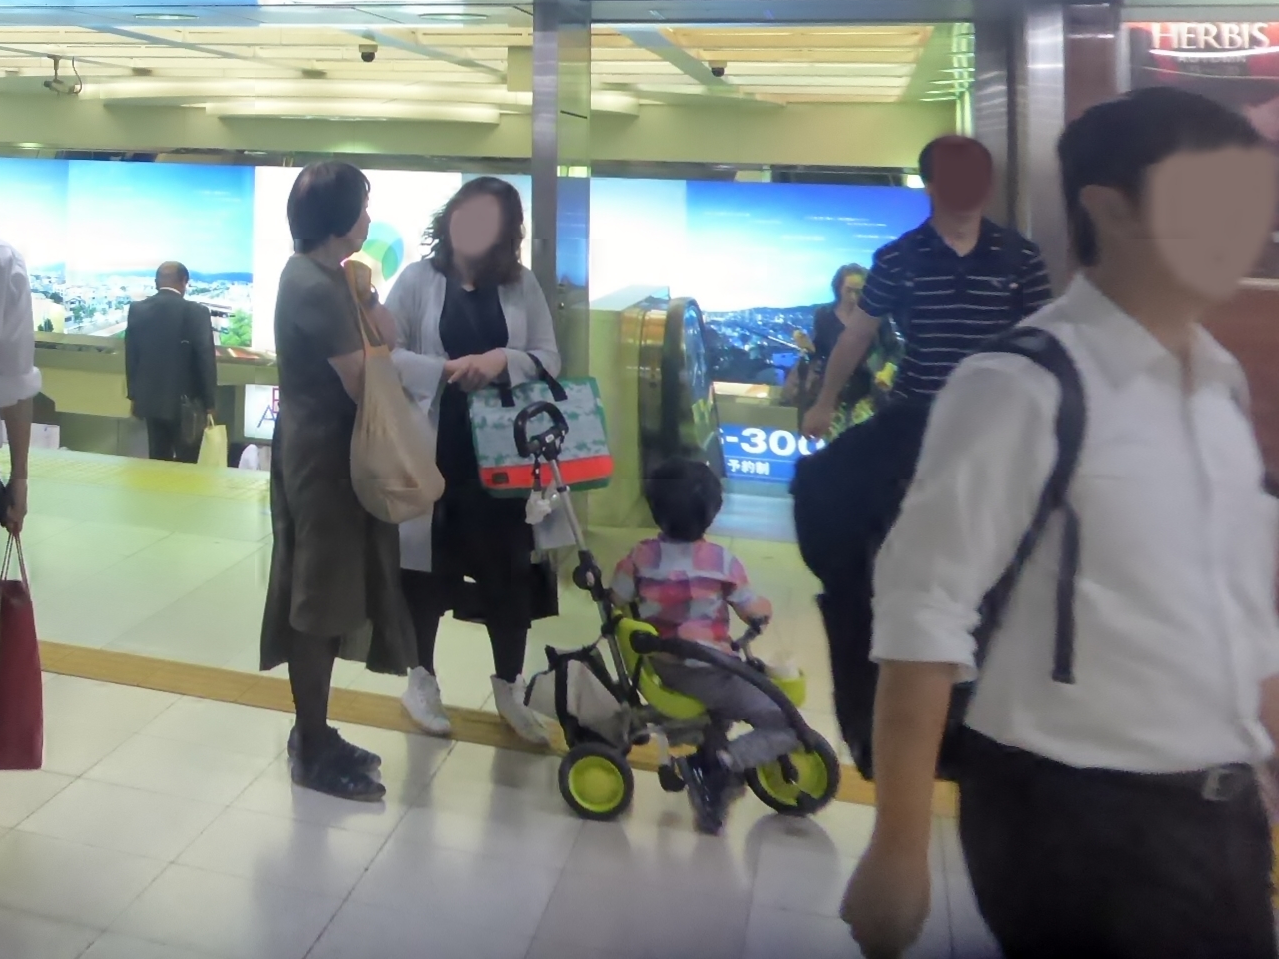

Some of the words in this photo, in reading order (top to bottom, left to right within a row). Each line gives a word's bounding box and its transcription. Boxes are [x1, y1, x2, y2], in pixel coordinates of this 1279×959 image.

[1151, 21, 1271, 50] HERBIS
[726, 458, 771, 476] 予約制
